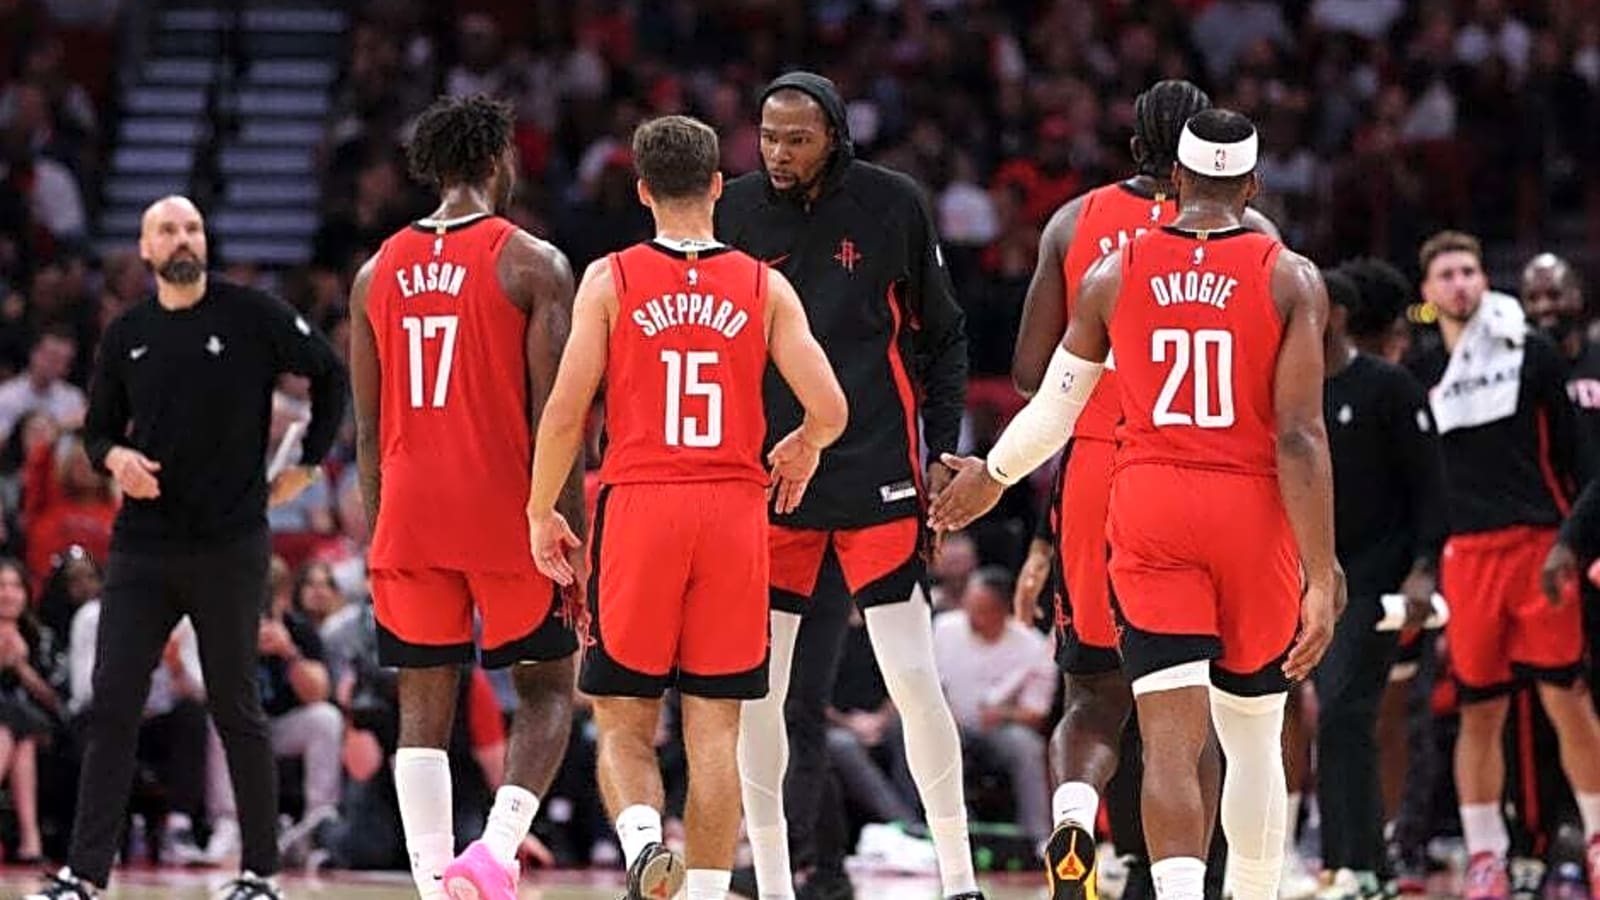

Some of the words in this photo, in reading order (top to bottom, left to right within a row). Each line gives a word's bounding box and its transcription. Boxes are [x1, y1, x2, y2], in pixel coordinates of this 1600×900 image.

[396, 262, 466, 298] EASON
[1150, 270, 1239, 311] OKOGIE
[632, 293, 748, 338] SHEPPARD
[402, 315, 458, 408] 17
[1152, 328, 1235, 428] 20
[660, 349, 722, 447] 15
